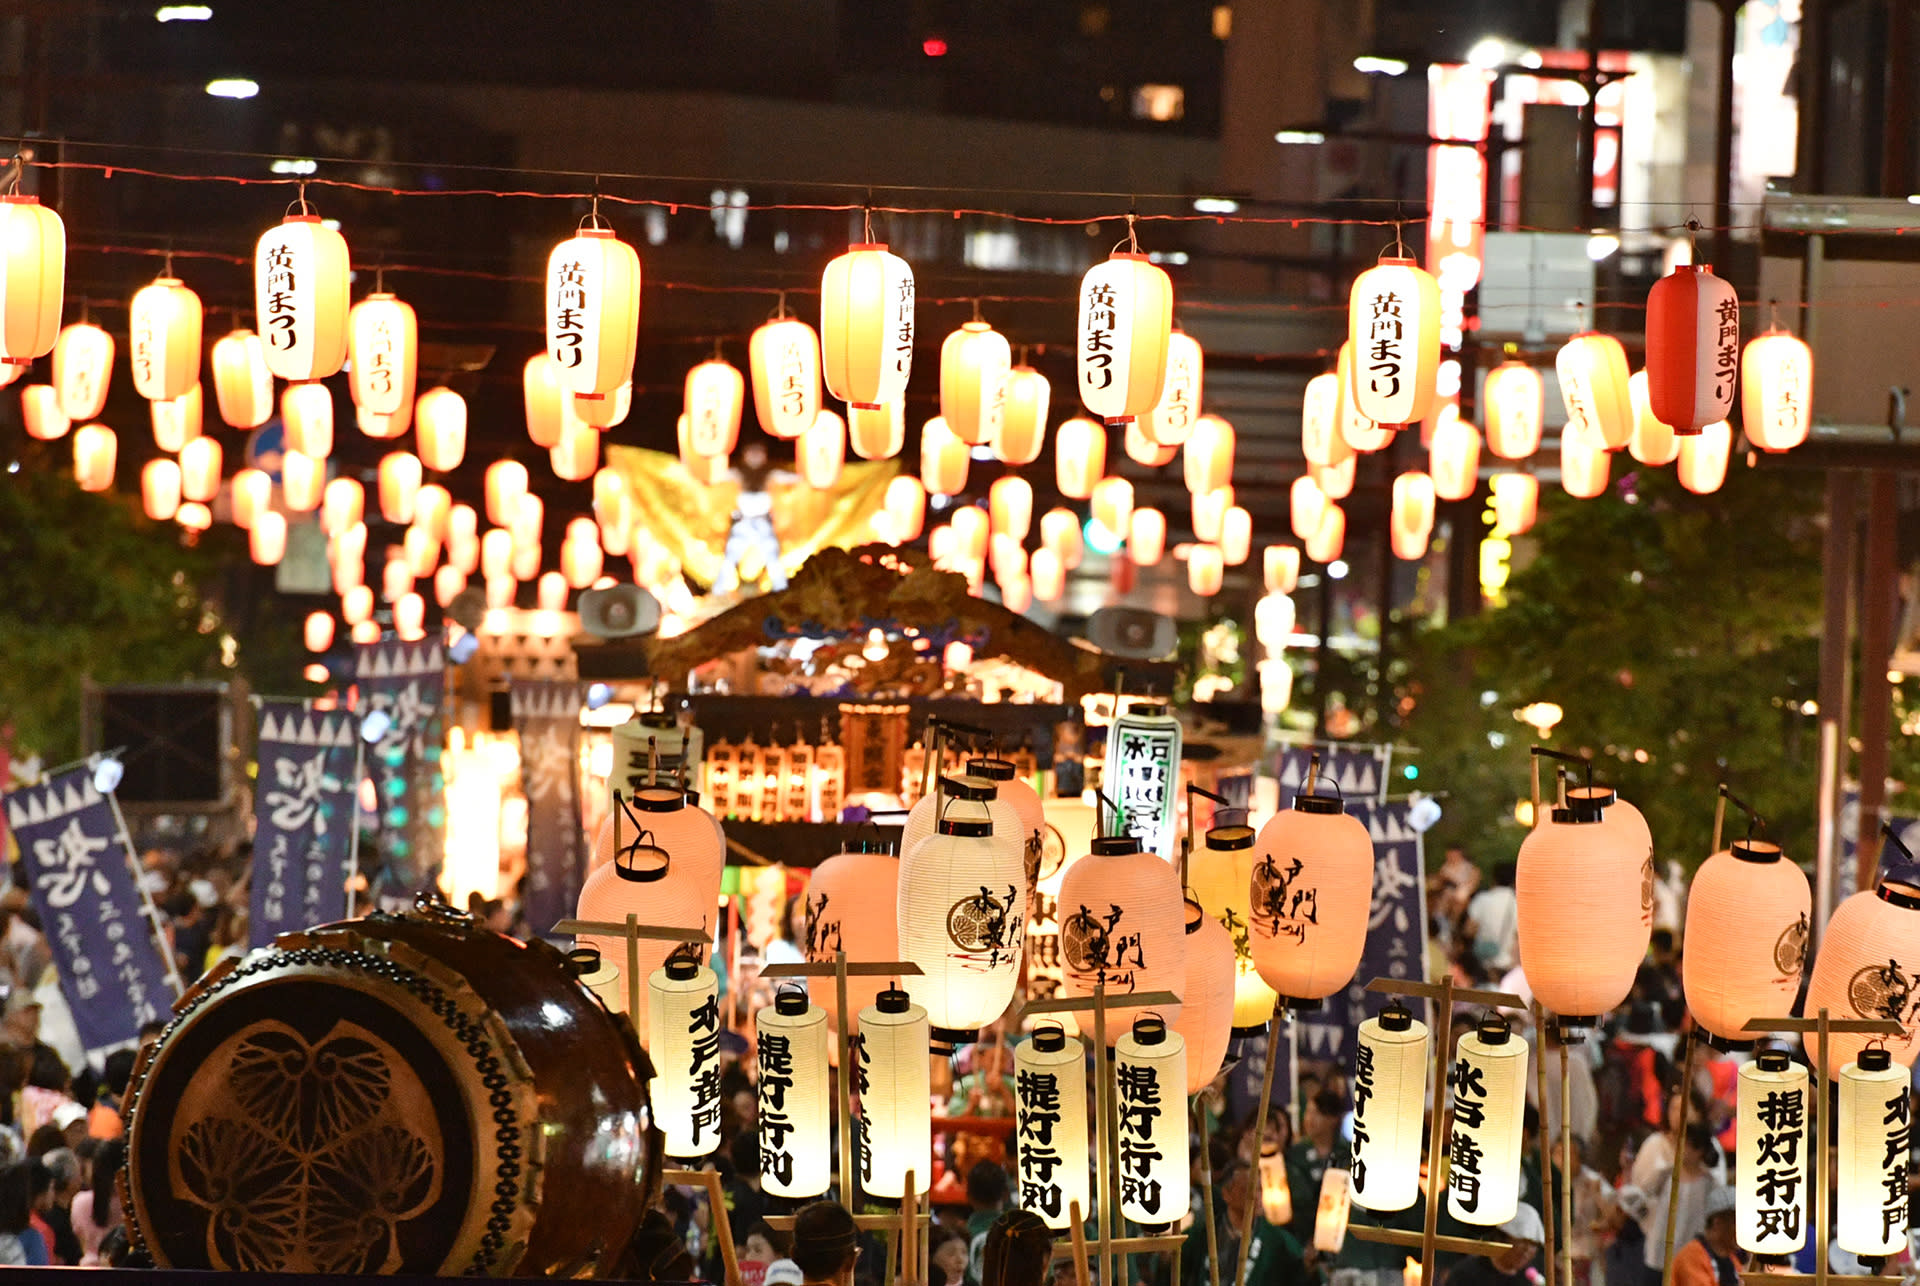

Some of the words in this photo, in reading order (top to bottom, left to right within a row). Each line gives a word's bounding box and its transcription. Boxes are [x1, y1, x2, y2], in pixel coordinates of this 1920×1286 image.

[266, 245, 296, 351] 黄門まつり
[556, 261, 586, 368] 黄門まつり
[1086, 284, 1117, 389] 黄門まつり
[1369, 291, 1403, 398] 黄門まつり
[1716, 297, 1738, 404] 黄門まつり
[1124, 737, 1171, 761] 水戸
[689, 995, 720, 1146] 水戸黄門
[758, 1030, 794, 1187] 提灯行列
[1017, 1069, 1062, 1218] 提灯行列
[1117, 1062, 1163, 1215] 提灯行列
[1449, 1058, 1487, 1213] 水戸黄門
[1756, 1088, 1804, 1243] 提灯行列
[1882, 1086, 1911, 1244] 水戸黄門
